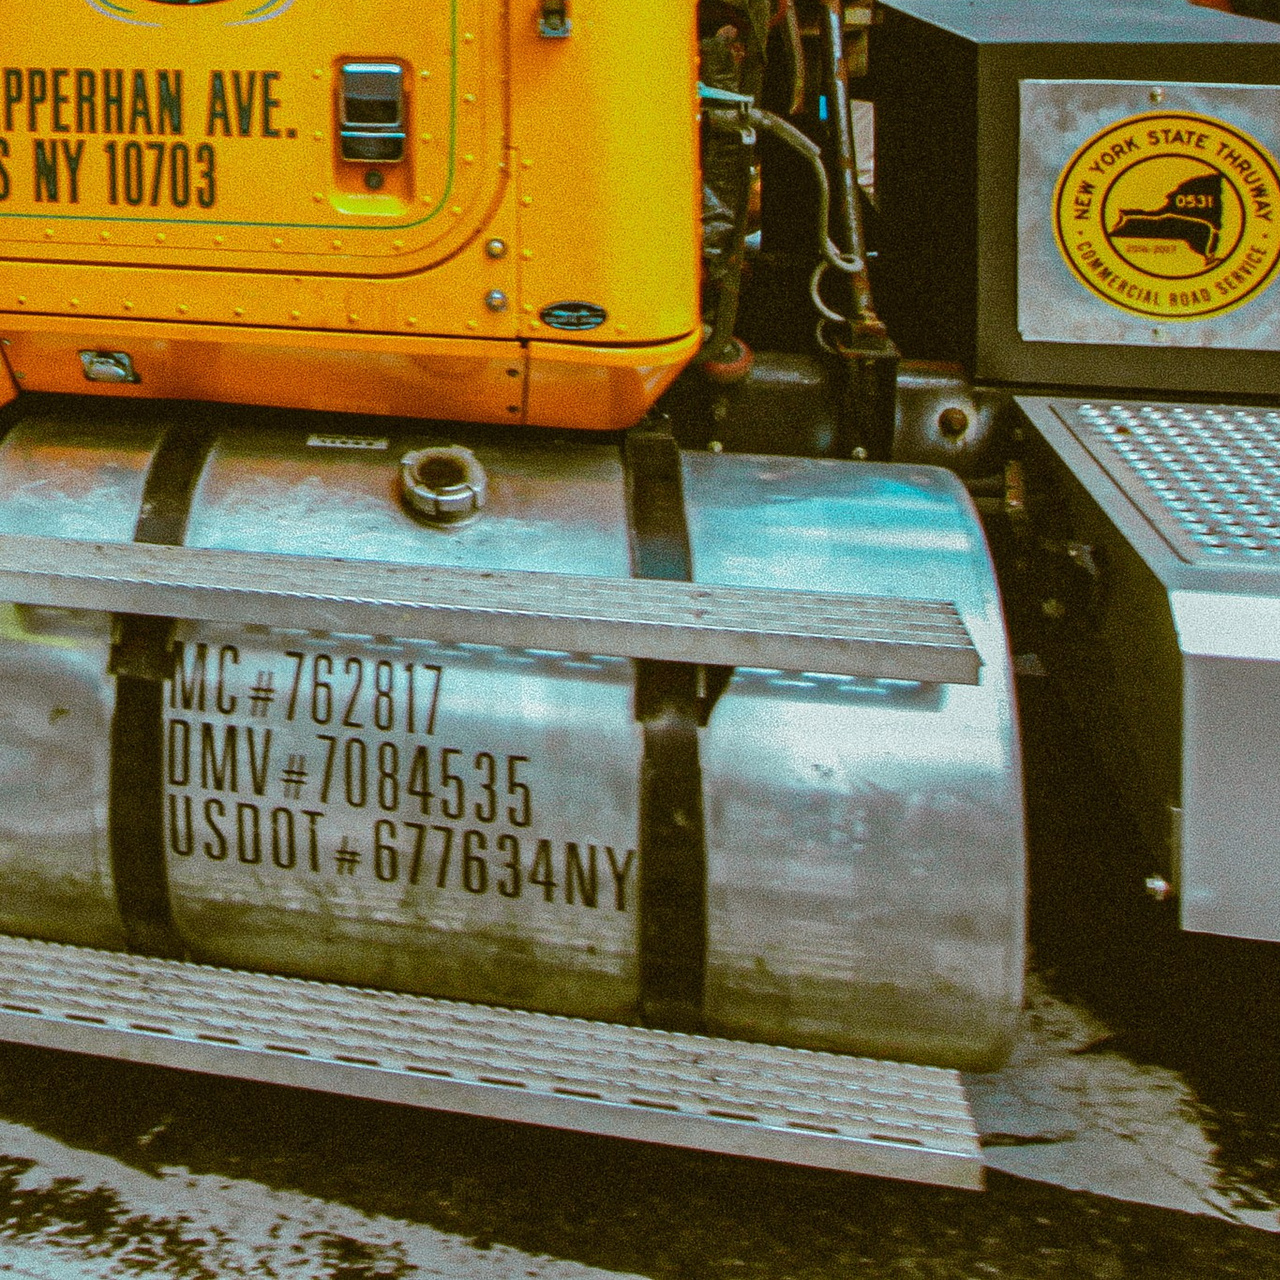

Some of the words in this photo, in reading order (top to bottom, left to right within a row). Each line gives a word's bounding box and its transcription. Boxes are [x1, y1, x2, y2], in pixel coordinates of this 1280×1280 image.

[206, 70, 298, 139] AVE.
[33, 138, 86, 204] NY
[104, 140, 216, 209] 10703
[1074, 180, 1096, 221] NEW
[1089, 136, 1140, 175] YORK
[1146, 128, 1210, 149] STATE
[1214, 141, 1274, 224] THRUWAY
[1076, 239, 1160, 307] COMMERCIAL
[1170, 287, 1213, 308] ROAD
[1214, 244, 1268, 296] SERVICE
